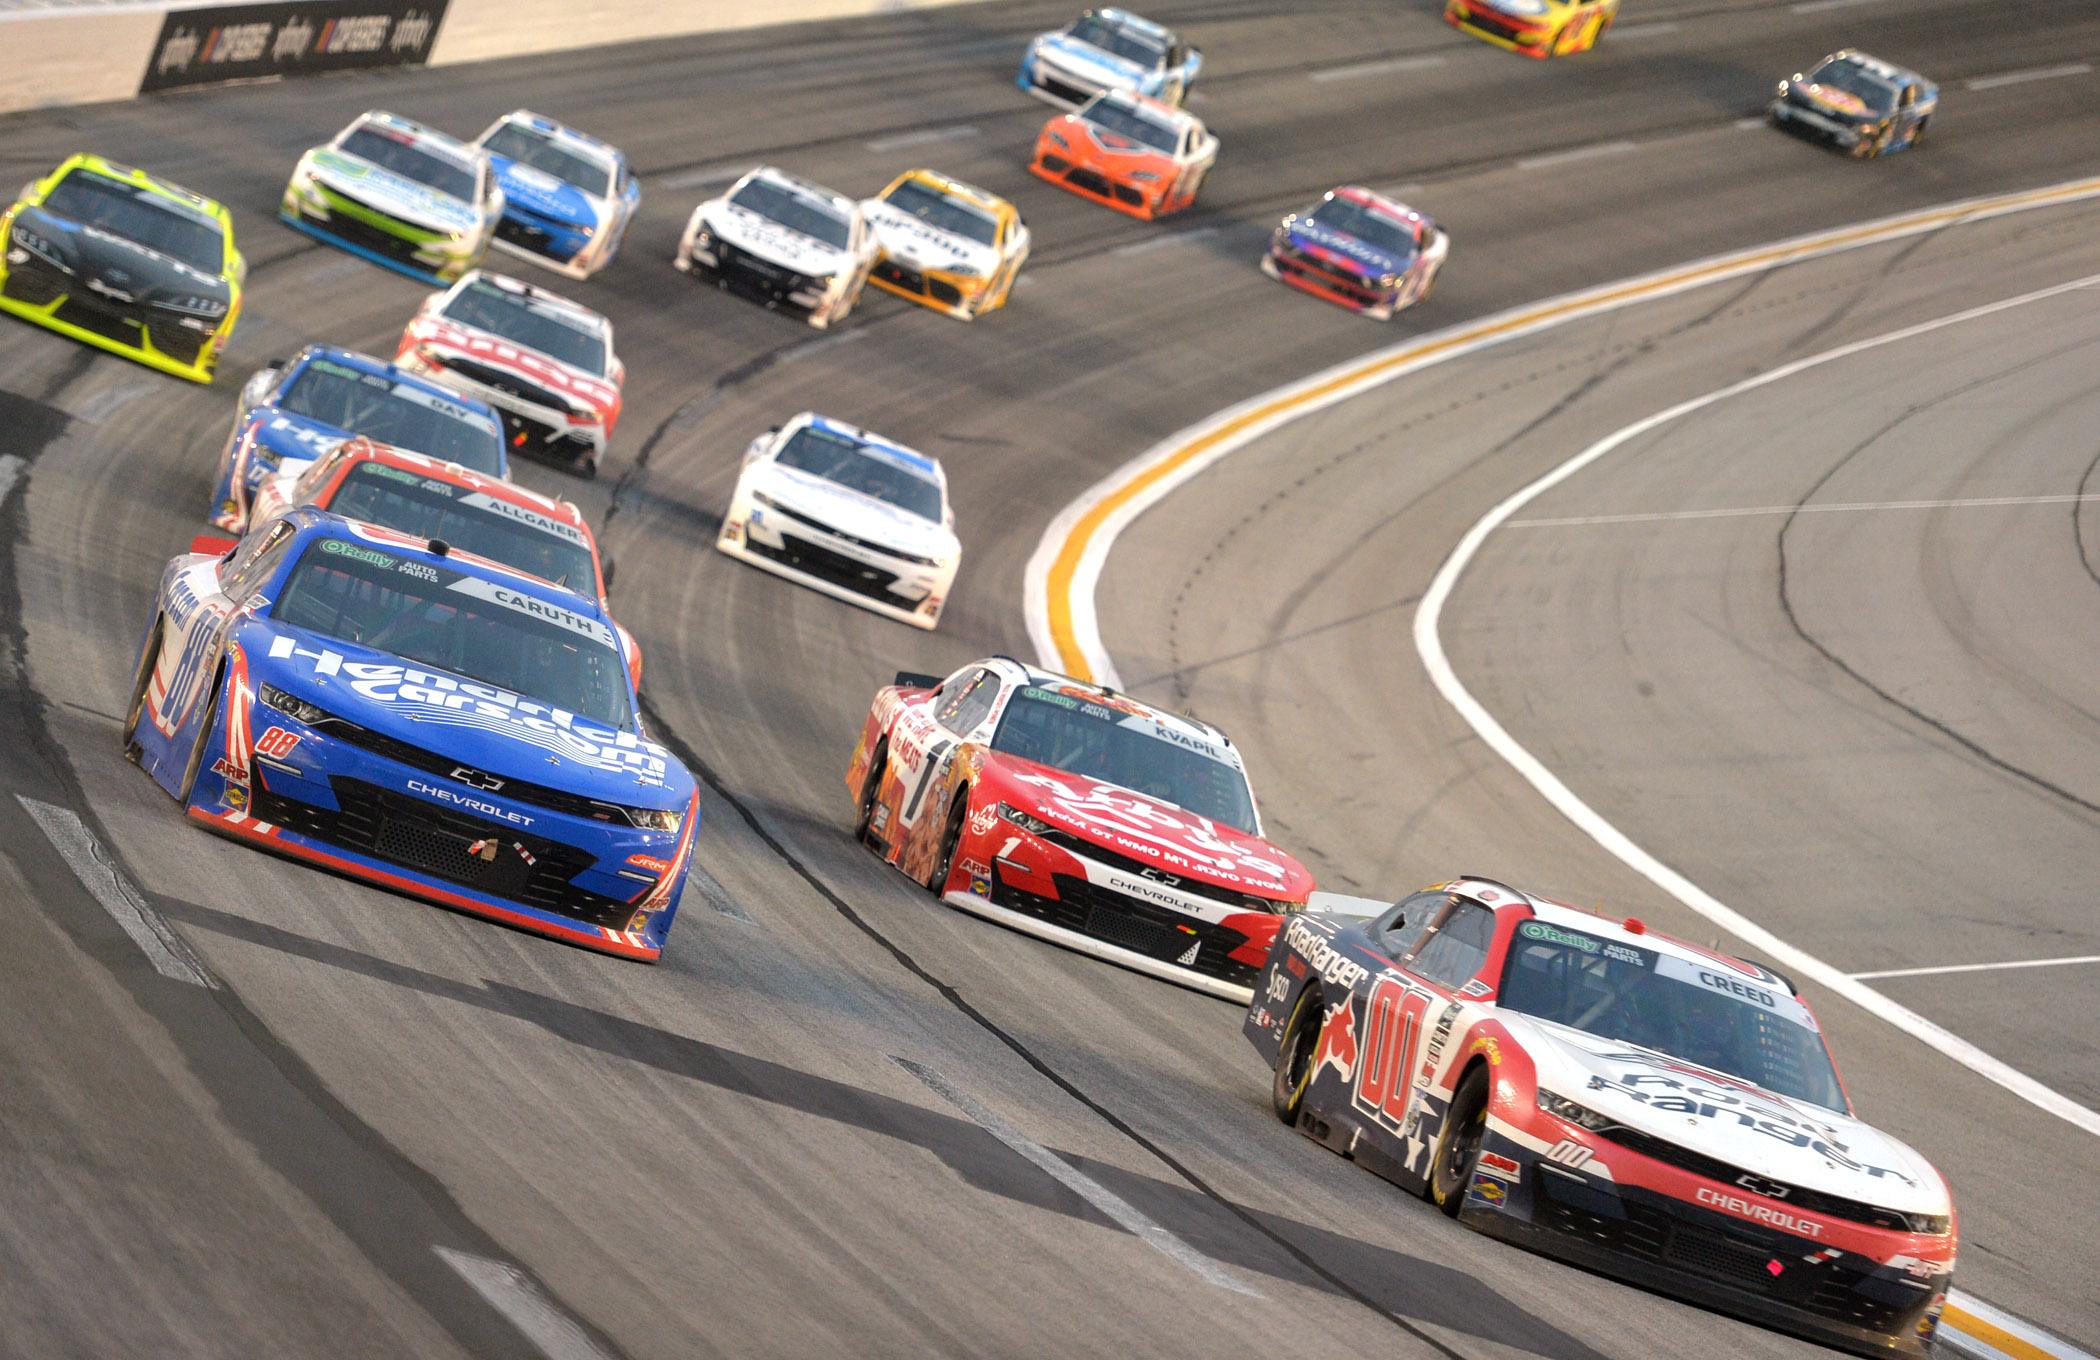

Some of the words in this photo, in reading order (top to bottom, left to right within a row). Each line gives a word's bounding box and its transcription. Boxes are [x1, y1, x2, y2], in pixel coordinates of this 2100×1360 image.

[431, 399, 467, 418] DAY
[489, 501, 579, 539] ALLGAIER
[398, 566, 439, 583] PARTS
[404, 561, 437, 575] AUTO
[494, 590, 593, 633] CARUTH
[269, 635, 668, 758] Hendrick
[255, 727, 300, 758] 88
[1155, 727, 1221, 759] KVAPIL
[213, 759, 249, 780] ARP
[408, 780, 535, 827] CHEVROLET
[997, 836, 1023, 858] 1
[962, 860, 990, 876] ARP
[1110, 877, 1204, 914] CHEVROLET
[1521, 922, 1601, 954] O'Reilly
[1606, 944, 1640, 958] AUTO
[1603, 948, 1645, 968] PARTS
[1699, 971, 1776, 1008] CREED
[1352, 968, 1433, 1139] 00
[1544, 1139, 1596, 1168] 00
[1696, 1187, 1823, 1238] CHEVROLET
